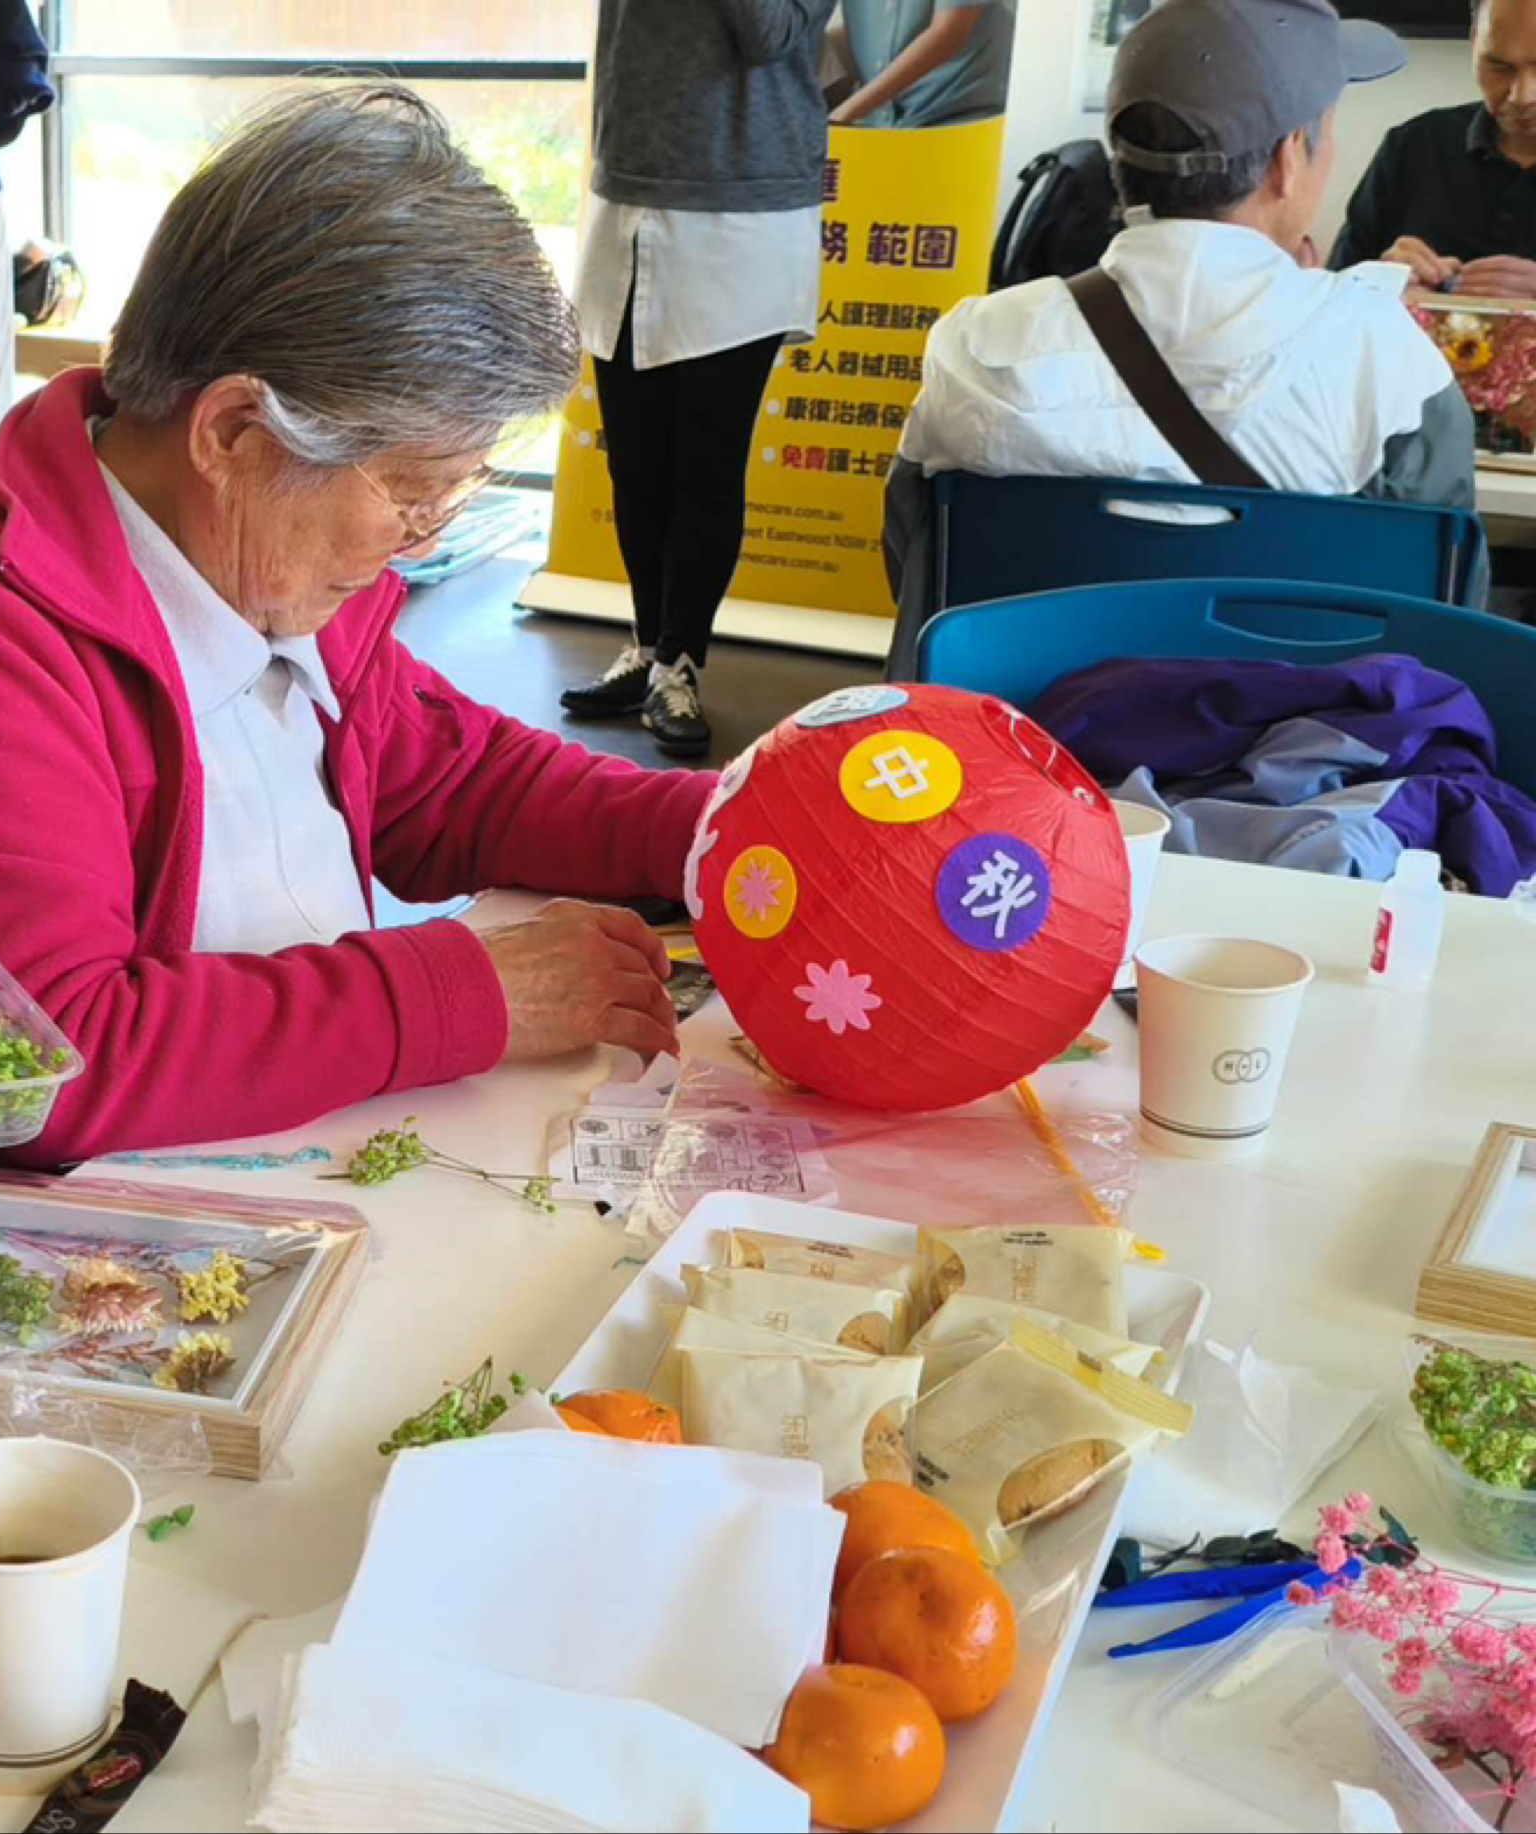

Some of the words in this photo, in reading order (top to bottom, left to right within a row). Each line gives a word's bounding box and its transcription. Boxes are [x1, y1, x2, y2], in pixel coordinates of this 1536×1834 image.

[867, 222, 957, 268] 範圍
[767, 528, 831, 546] Eastwood
[865, 745, 930, 799] 中
[961, 850, 1038, 939] 秋
